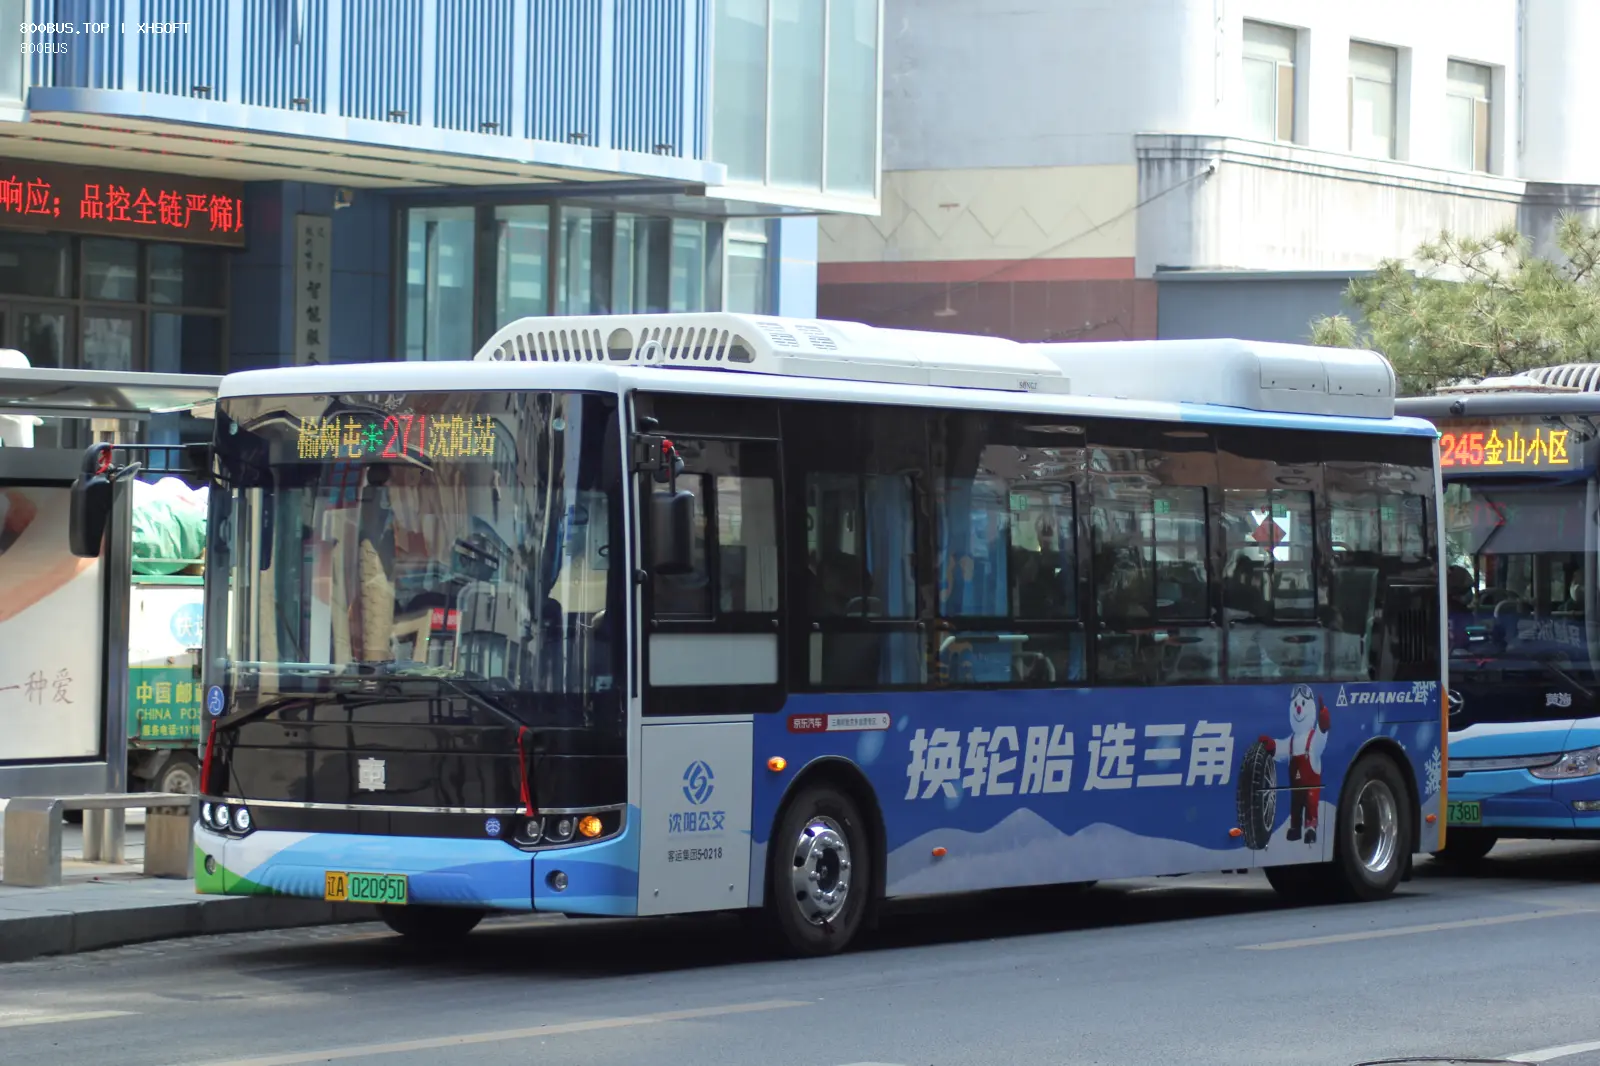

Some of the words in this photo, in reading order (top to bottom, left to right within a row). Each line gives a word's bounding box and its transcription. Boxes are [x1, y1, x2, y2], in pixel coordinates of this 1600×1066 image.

[381, 415, 425, 458] 271
[1440, 432, 1484, 467] 245
[1484, 428, 1568, 465] 金山小区
[1350, 691, 1426, 704] TRIANGLE
[135, 708, 172, 721] CHINA
[793, 717, 822, 729] 京东汽车
[668, 810, 725, 833] 沈阳公交
